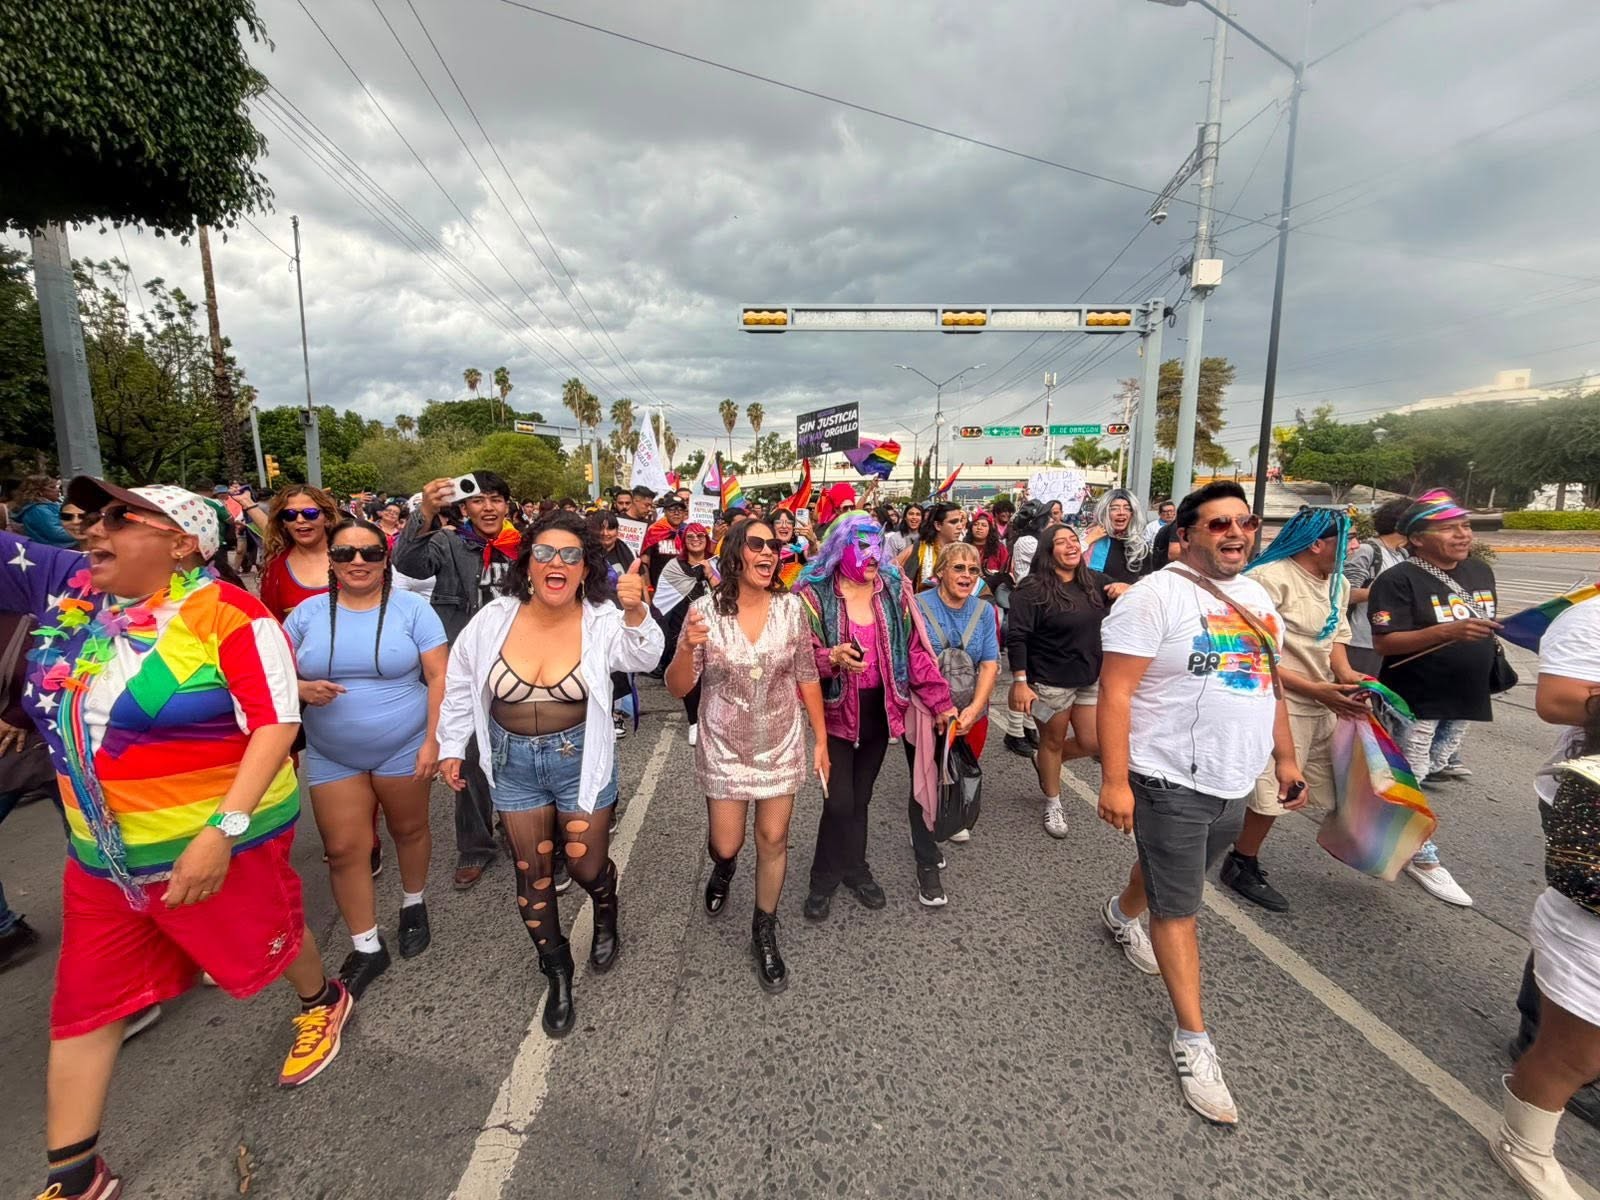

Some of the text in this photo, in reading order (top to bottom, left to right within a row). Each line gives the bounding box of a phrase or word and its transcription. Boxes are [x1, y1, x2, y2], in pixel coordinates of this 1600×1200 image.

[798, 420, 816, 434] SIN
[817, 409, 858, 430] JUSTICIA
[824, 421, 858, 438] ORGULLO
[625, 533, 640, 541] AMOR
